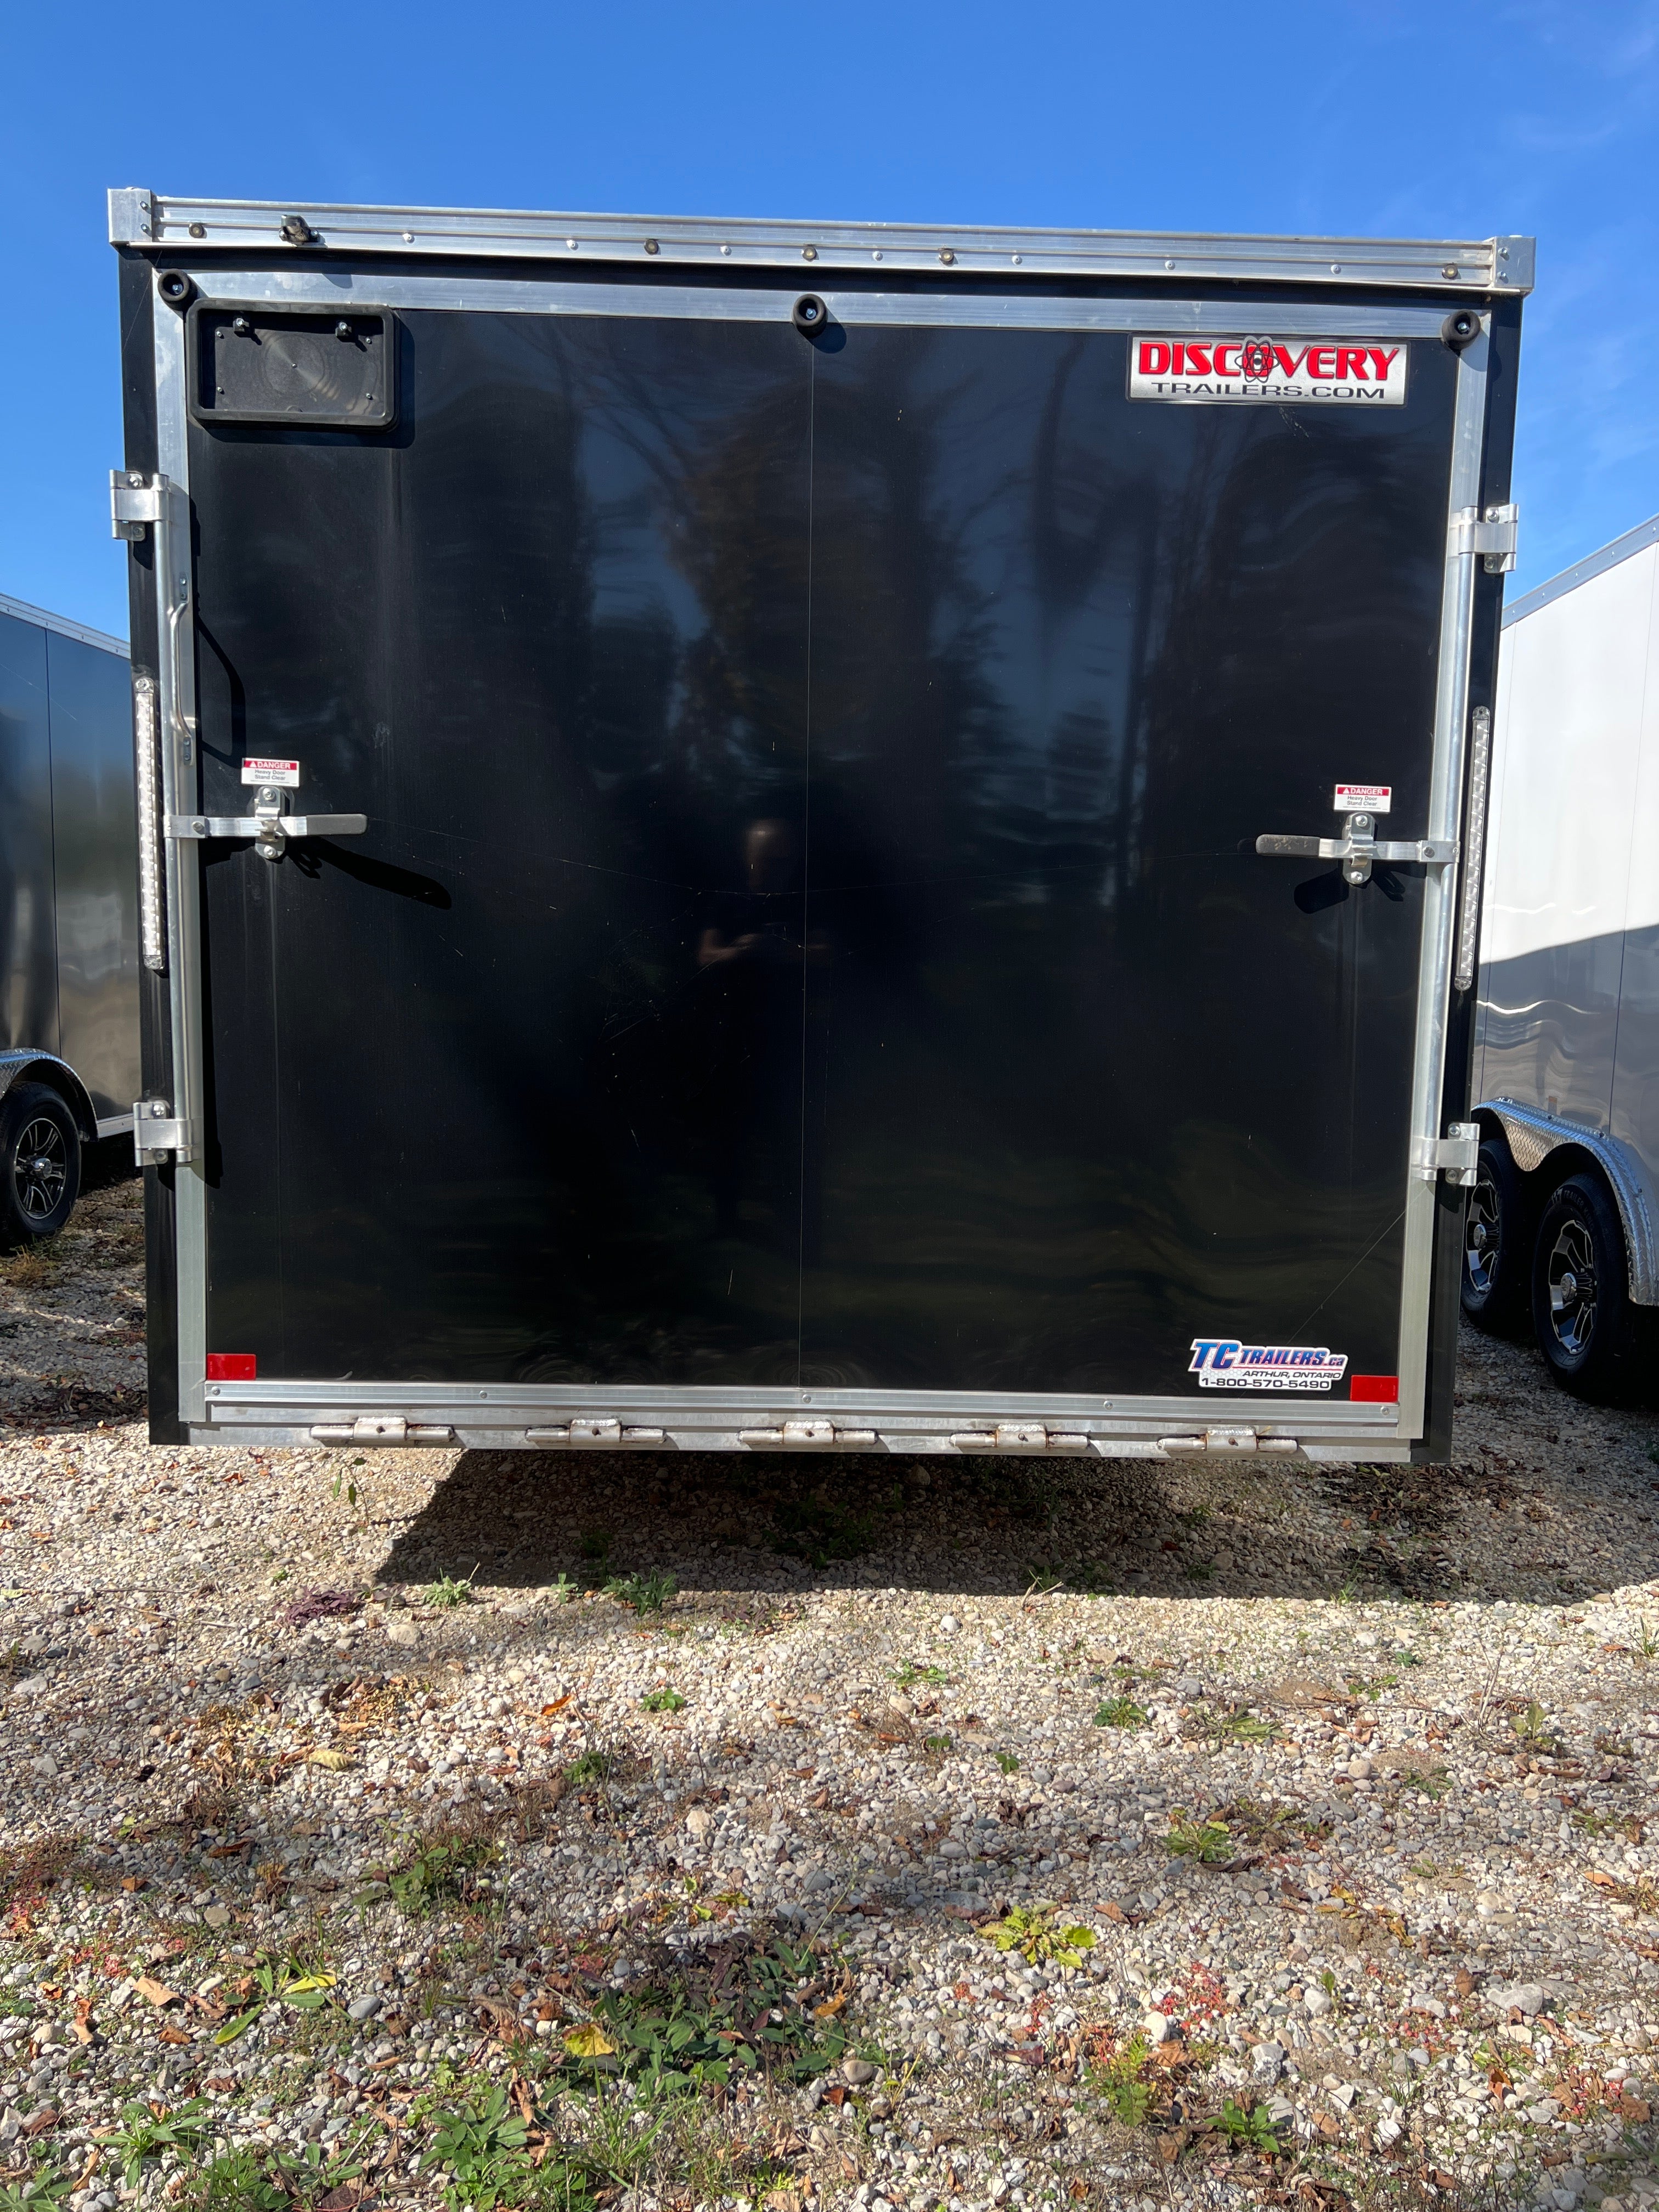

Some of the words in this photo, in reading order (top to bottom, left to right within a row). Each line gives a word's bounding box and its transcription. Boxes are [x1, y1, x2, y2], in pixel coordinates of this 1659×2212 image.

[1139, 341, 1400, 381] DISCOVERY
[1152, 382, 1385, 399] TRAILERS.COM
[1192, 1342, 1240, 1370] TC
[1201, 1378, 1330, 1389] 1-800-570-5490
